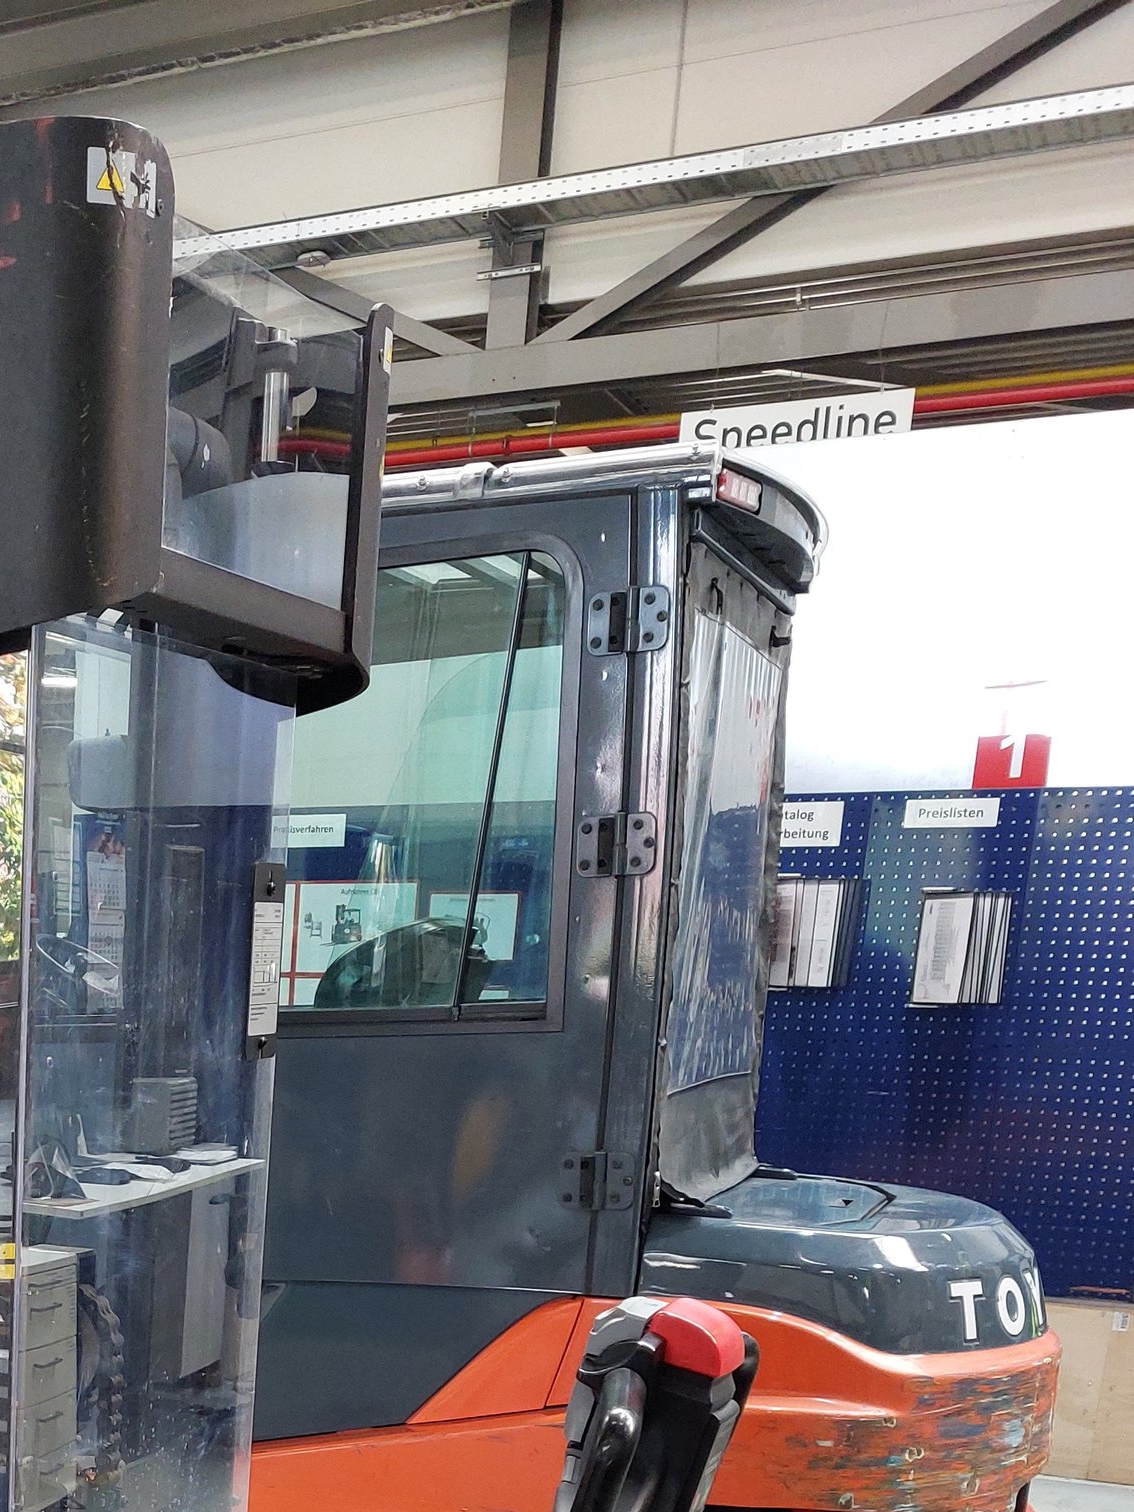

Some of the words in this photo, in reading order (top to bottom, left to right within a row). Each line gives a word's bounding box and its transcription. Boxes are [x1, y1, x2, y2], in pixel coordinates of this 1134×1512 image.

[694, 404, 897, 448] Speedline
[1000, 733, 1026, 778] 1
[784, 809, 814, 821] talog
[918, 807, 984, 818] Preislisten
[273, 824, 334, 834] Praisverfahren
[780, 828, 829, 841] rbeitung
